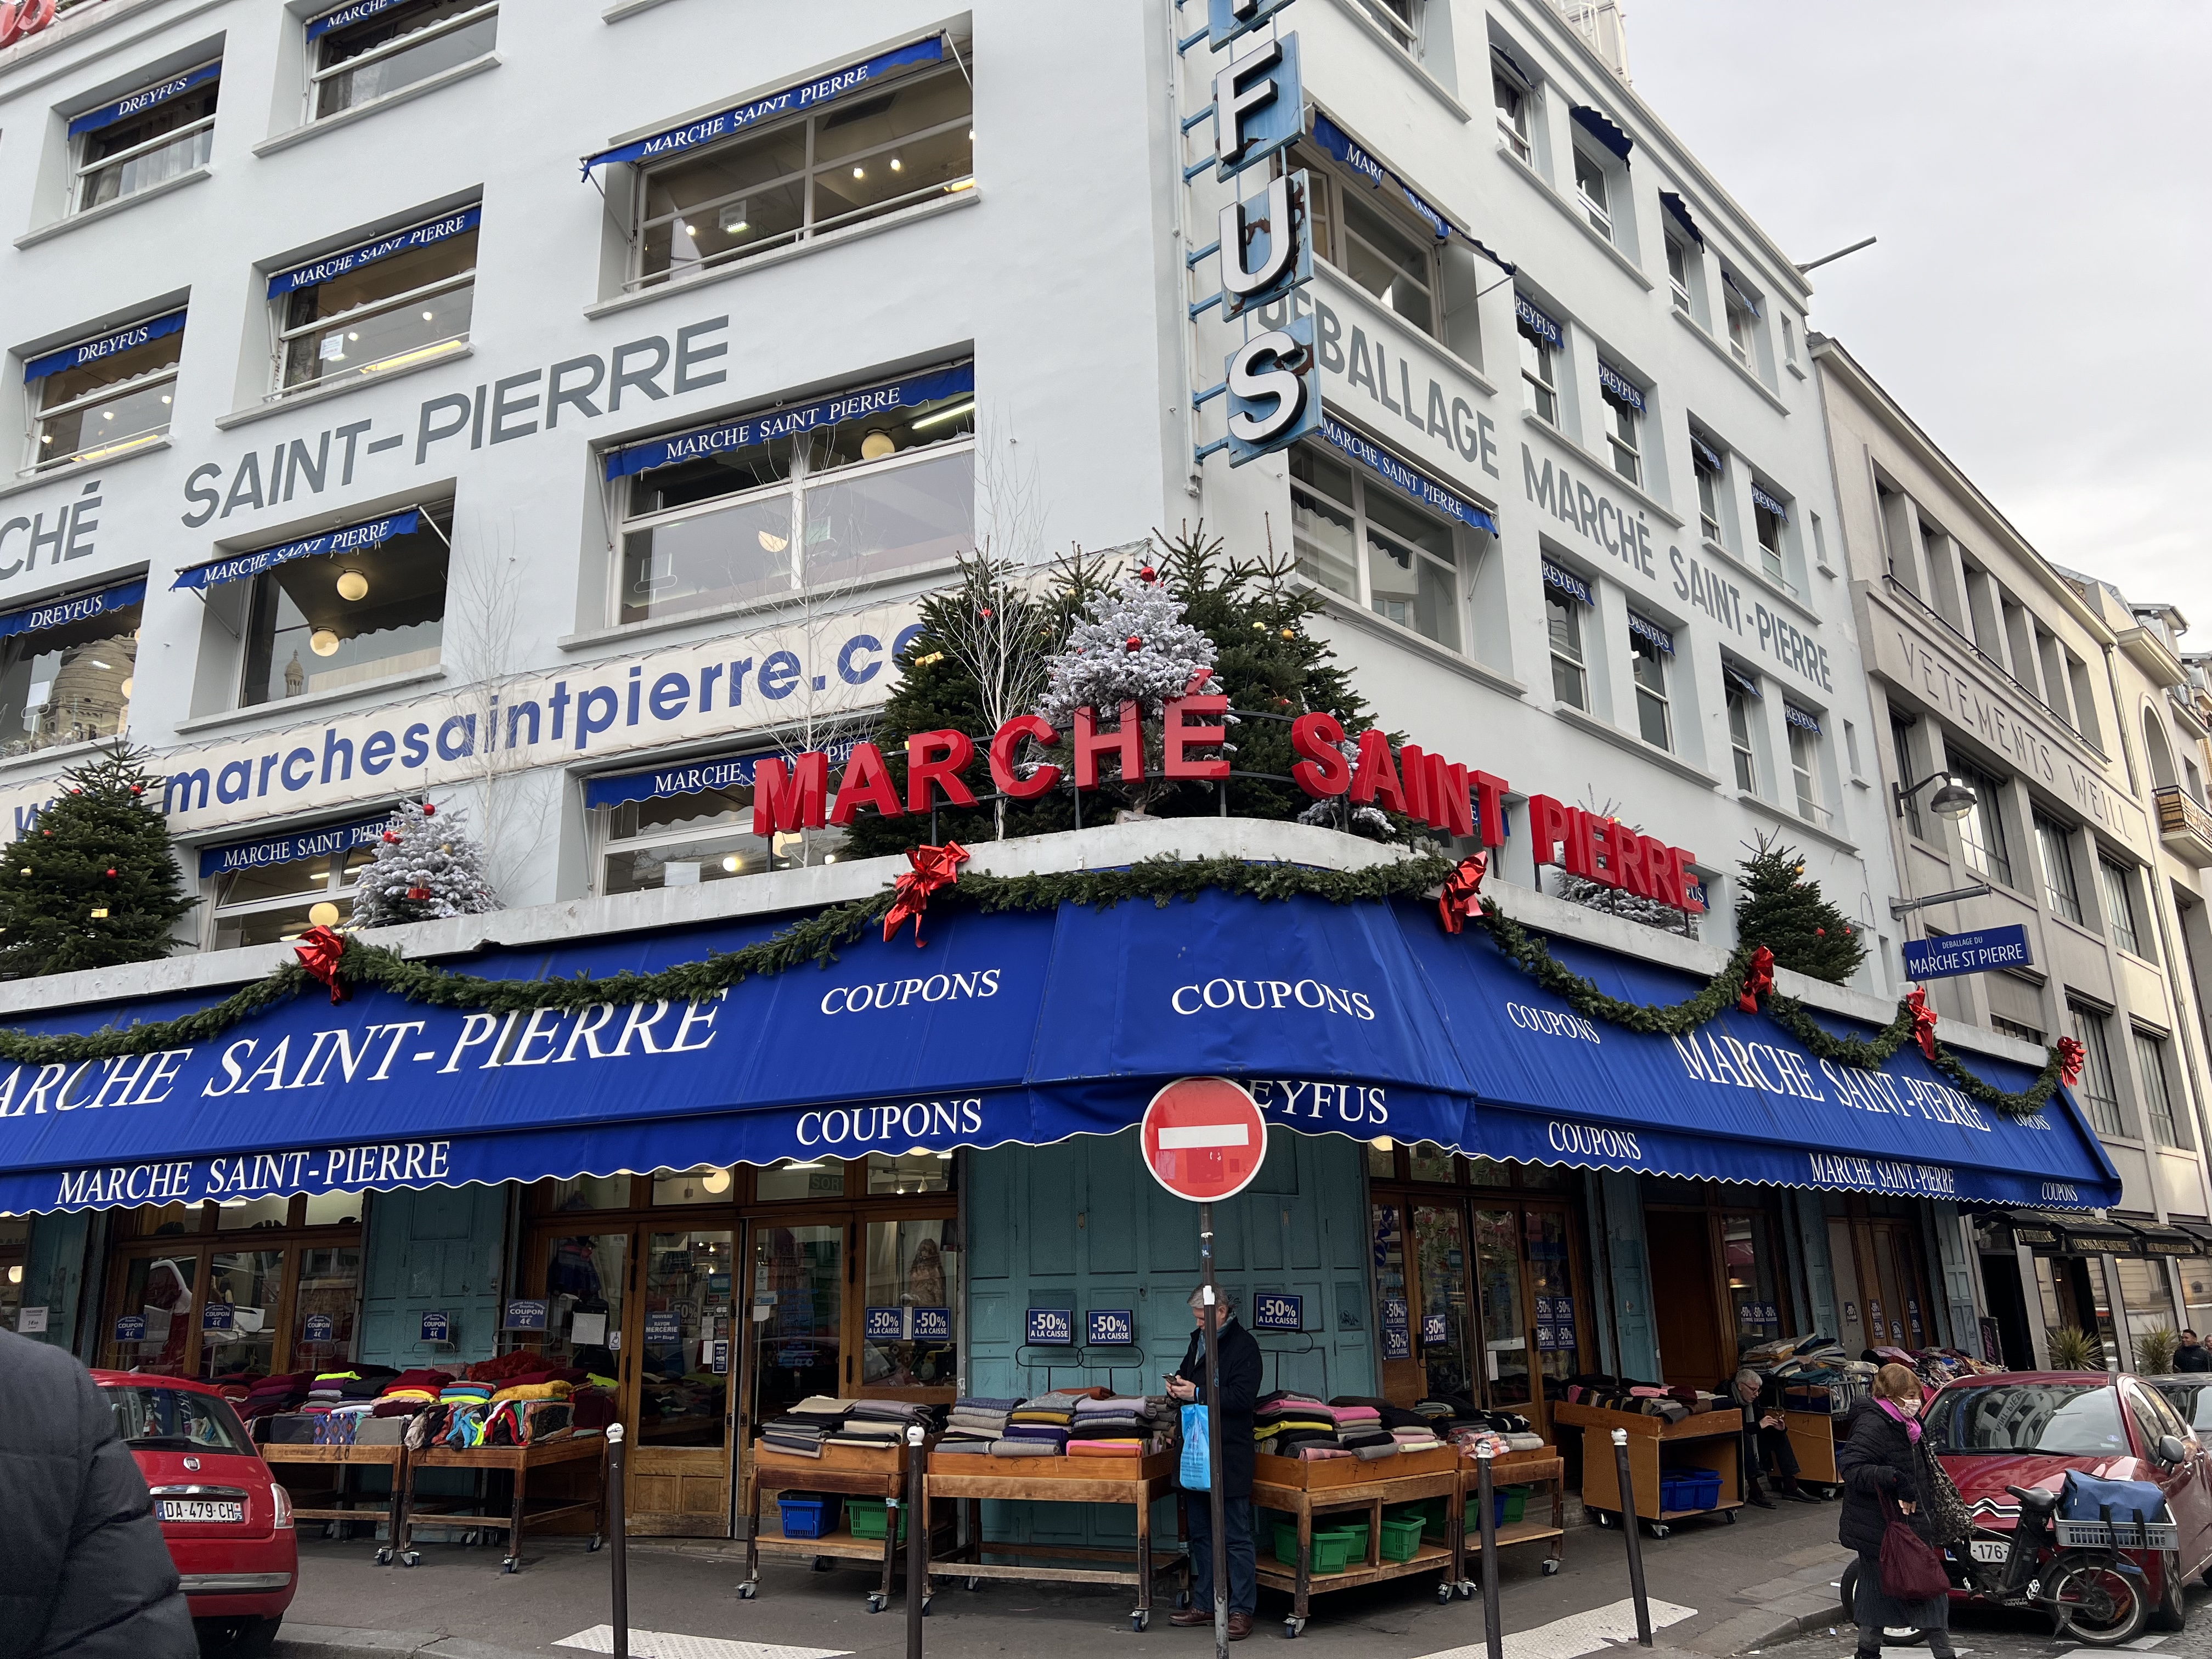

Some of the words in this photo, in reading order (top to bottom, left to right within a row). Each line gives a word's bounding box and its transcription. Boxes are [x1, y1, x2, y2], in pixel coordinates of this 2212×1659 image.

[118, 78, 188, 116] DREYFUS
[642, 117, 724, 156] MARCHE
[733, 94, 791, 128] SAINT
[799, 66, 868, 105] PIERRE
[1345, 143, 1384, 183] MARC
[1216, 0, 1308, 445] FUS
[291, 255, 353, 287] MARCHE
[358, 237, 405, 264] SAINT
[409, 216, 465, 246] PIERRE
[1515, 295, 1556, 340] REYFUS
[78, 327, 148, 363] DREYFUS
[181, 314, 729, 529] SAINT-PIERRE
[665, 425, 749, 460] MARCHE
[759, 408, 820, 438] SAINT
[828, 387, 900, 420] PIERRE
[1323, 421, 1378, 466] MARCHE
[1382, 457, 1418, 492] SAINT
[1423, 482, 1464, 518] PIERRE
[202, 554, 268, 585] MARCHE
[273, 538, 325, 562] SAINT
[329, 521, 390, 549] PIERRE
[1521, 441, 1656, 582] MARCHÉ
[1669, 545, 1834, 696] SAINT-PIERRE
[1542, 561, 1586, 599] REYFUS
[29, 594, 103, 629] DREYFUS
[654, 763, 743, 797] MARCHE
[826, 740, 868, 763] PIE
[753, 669, 1231, 838] MARCHÉ
[1291, 712, 1509, 848] SAINT
[1529, 794, 1703, 914] PIERRE
[2067, 763, 2134, 843] WEILL
[223, 841, 291, 869] MARCHE
[296, 831, 343, 857] SAINT
[351, 820, 404, 845] PIER
[1909, 953, 1960, 976] MARCHE
[1962, 950, 1976, 968] ST
[1978, 943, 2024, 965] PIERRE
[1942, 937, 1973, 950] DEBALLAGE
[1974, 936, 1983, 946] DU
[821, 969, 1001, 1015] COUPONS
[1171, 978, 1376, 1021] COUPONS
[1506, 1002, 1601, 1044] COUPONS
[0, 1048, 193, 1118] ARCHE
[201, 987, 729, 1098] SAINT-PIERRE
[1246, 1079, 1389, 1125] EYFUS
[1670, 1030, 1825, 1102] MARCHE
[1820, 1057, 1991, 1132] SAINT-PIERRE
[796, 1098, 981, 1146] COUPONS
[1548, 1121, 1641, 1160] COUPONS
[55, 1161, 193, 1205] MARCHE
[206, 1141, 450, 1194] SAINT-PIERRE
[812, 1176, 844, 1191] SOR
[1809, 1153, 1875, 1186] MARCHE
[1877, 1159, 1955, 1194] SAINT-PIERRE
[2041, 1181, 2078, 1203] COUPONS
[870, 1312, 899, 1327] -50%
[916, 1312, 946, 1327] -50%
[1032, 1313, 1066, 1330] -50%
[1093, 1316, 1127, 1331] -50%
[1260, 1299, 1296, 1317] -50%
[1386, 1302, 1404, 1317] -50%
[1426, 1319, 1444, 1334] -50%
[1389, 1334, 1406, 1348] -50%
[166, 1502, 236, 1519] DA-479-CH
